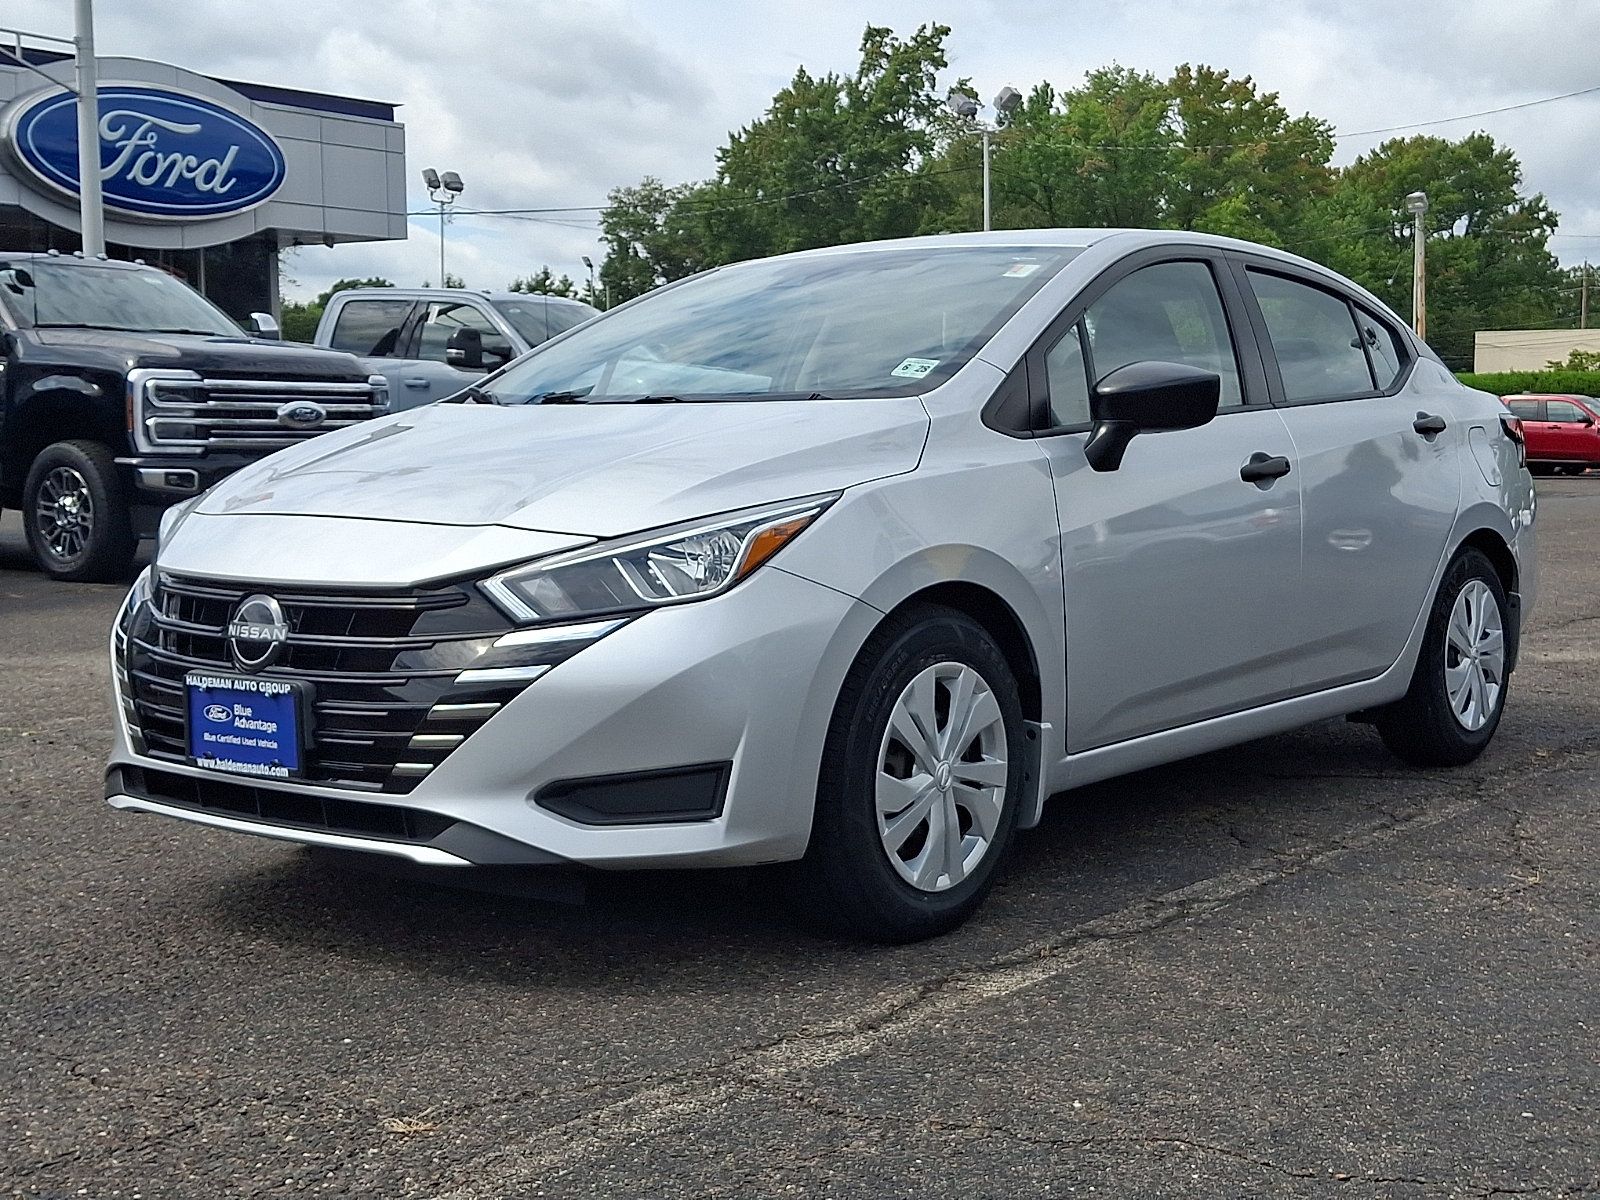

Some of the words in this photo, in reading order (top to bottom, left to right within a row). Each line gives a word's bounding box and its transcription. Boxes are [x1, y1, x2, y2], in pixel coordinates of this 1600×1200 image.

[99, 109, 241, 194] Ford
[227, 623, 286, 640] NISSAN
[185, 675, 232, 690] HALDEMAN
[233, 679, 257, 692] AUTO
[258, 682, 291, 695] GROUP
[208, 705, 228, 720] Ford
[233, 703, 253, 717] Blue
[233, 716, 278, 734] Advantage
[203, 732, 217, 742] Blue
[216, 733, 241, 745] Certified
[241, 736, 257, 747] Used
[257, 738, 278, 750] Vehicle
[196, 757, 289, 777] www.haldemanauto.com
